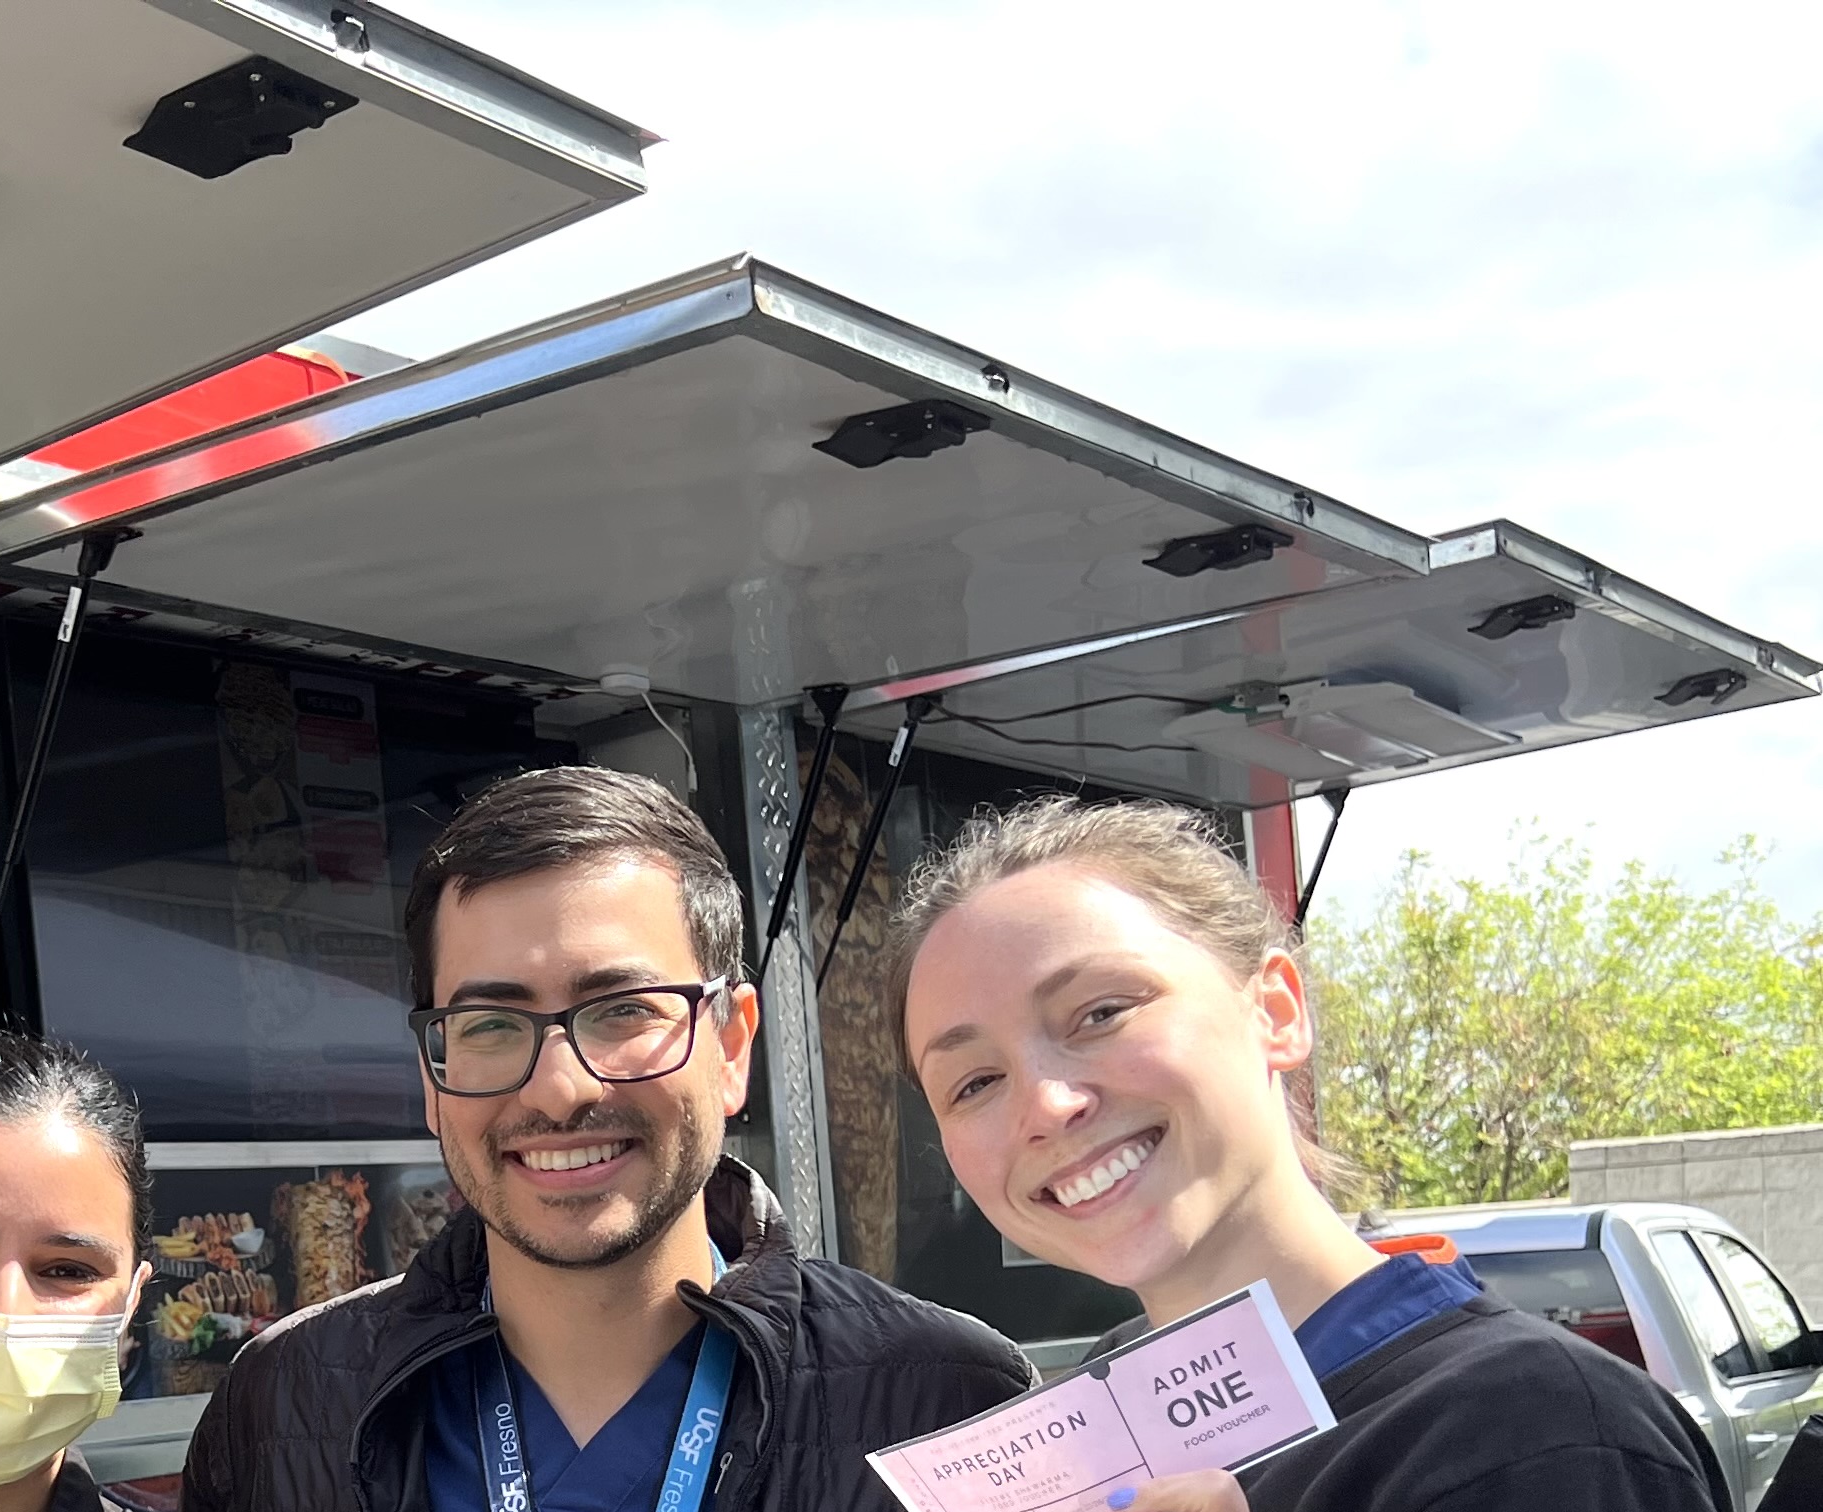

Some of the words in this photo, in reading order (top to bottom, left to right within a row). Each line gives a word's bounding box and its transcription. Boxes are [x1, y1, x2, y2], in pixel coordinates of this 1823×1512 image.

[1154, 1341, 1237, 1395] ADMIT
[1167, 1370, 1254, 1428] ONE
[1216, 1404, 1271, 1434] VOUCHER
[495, 1402, 522, 1476] Fresno
[679, 1407, 720, 1466] UCSF
[932, 1410, 1087, 1481] APPRECIATION
[988, 1462, 1026, 1486] DAY
